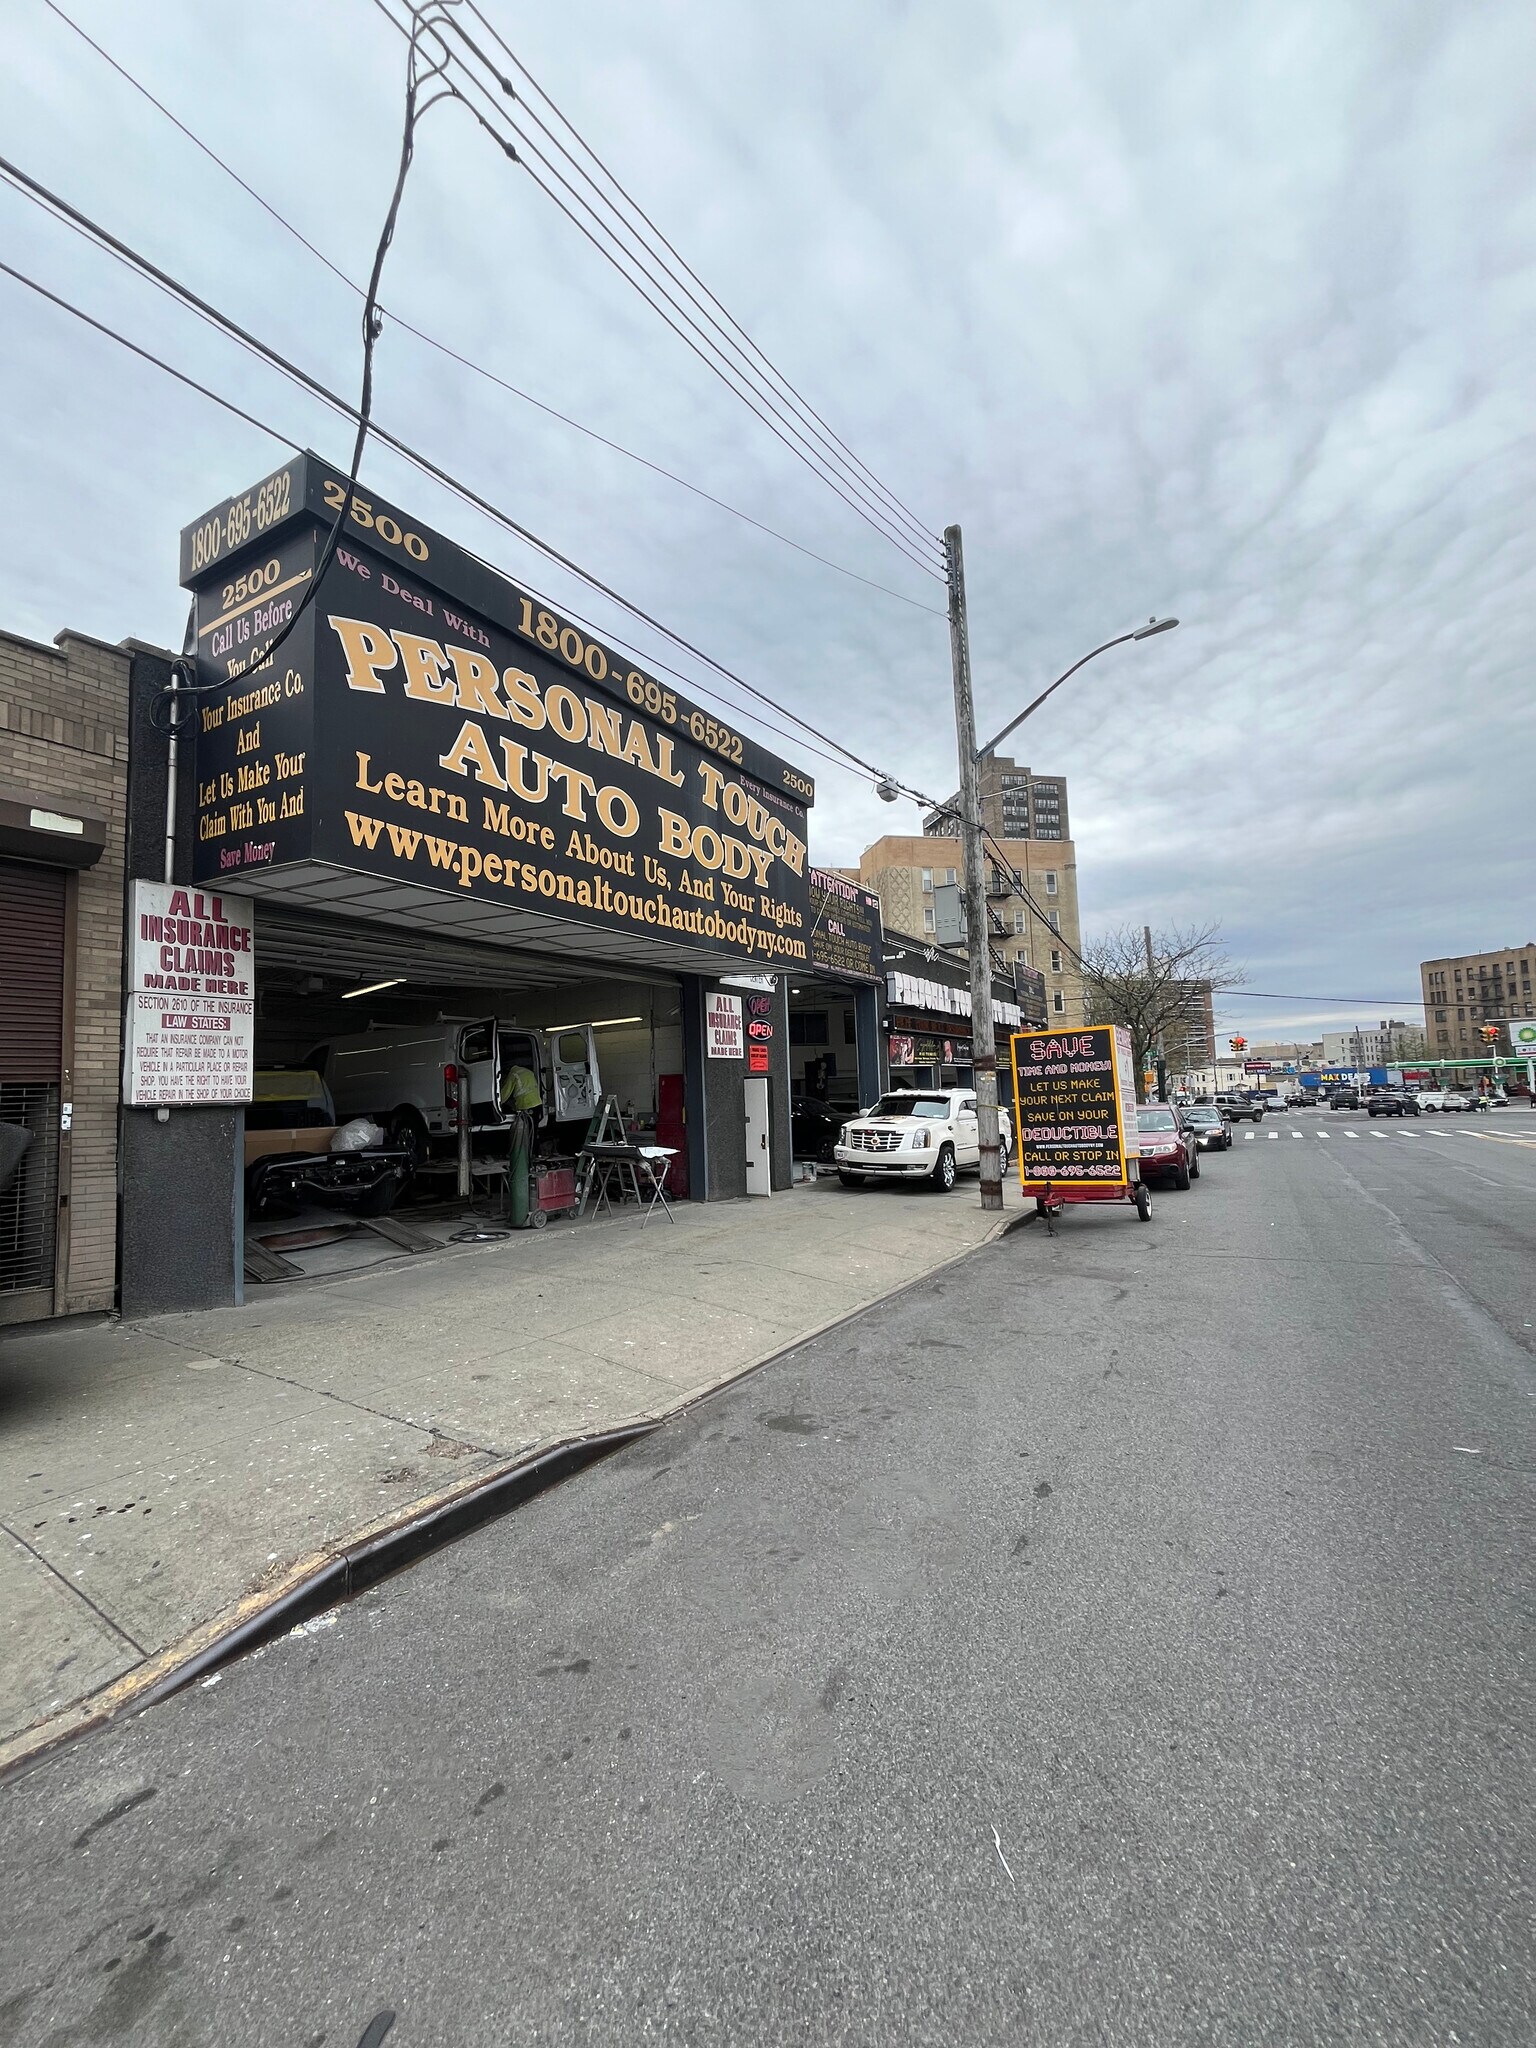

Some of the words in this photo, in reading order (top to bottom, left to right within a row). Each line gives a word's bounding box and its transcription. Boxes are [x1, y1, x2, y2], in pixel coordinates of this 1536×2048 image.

[190, 471, 290, 572] 1800-695-6522
[323, 480, 431, 562] 2500
[222, 560, 280, 610] 2500
[336, 547, 371, 580] We
[381, 574, 433, 617] Deal
[443, 607, 490, 648] With
[211, 629, 233, 658] Call
[237, 617, 249, 642] Us
[254, 598, 293, 635] Before
[517, 596, 744, 766] 1800-695-6522
[202, 704, 223, 733] Your
[227, 681, 281, 726] Insurance
[285, 671, 304, 695] Co.
[237, 721, 261, 755] And
[327, 614, 685, 788] PERSONAL
[698, 761, 807, 878] TOUCH
[200, 781, 217, 807] Let
[220, 773, 234, 796] Us
[238, 760, 270, 791] Make
[276, 751, 305, 778] Your
[782, 769, 814, 799] 2500
[439, 720, 640, 839] AUTO
[658, 806, 774, 890] BODY
[740, 775, 760, 796] Every
[763, 788, 793, 812] Insurance
[795, 805, 805, 819] Co.
[200, 808, 227, 841] Claim
[230, 799, 253, 832] With
[257, 794, 277, 821] You
[280, 786, 304, 815] And
[356, 750, 468, 824] Learn
[483, 796, 555, 850] More
[566, 832, 634, 878] About
[643, 857, 672, 891] Us,
[678, 867, 715, 902] And
[721, 880, 756, 916] Your
[760, 898, 802, 934] Rights
[220, 843, 242, 869] Save
[244, 840, 275, 865] Money
[169, 891, 228, 923] ALL
[141, 914, 251, 952] INSURANCE
[828, 920, 845, 936] CALL
[160, 945, 235, 977] CLAIMS
[144, 974, 201, 992] MADE
[205, 979, 249, 995] HERE
[139, 996, 169, 1010] SECTION
[172, 998, 187, 1011] 2610
[191, 999, 200, 1011] OF
[203, 1000, 215, 1012] THE
[218, 1001, 252, 1015] INSURANCE
[716, 996, 734, 1013] ALL
[751, 996, 771, 1015] OPEN
[166, 1015, 187, 1028] LAW
[192, 1017, 227, 1030] STATES:
[708, 1012, 742, 1030] INSURANCE
[749, 1023, 773, 1036] OPEN
[146, 1033, 159, 1043] THAT
[161, 1034, 168, 1043] AN
[170, 1035, 197, 1045] INSURANCE
[199, 1036, 221, 1045] COMPANY
[224, 1036, 233, 1046] CAN
[234, 1036, 243, 1046] NOT
[715, 1030, 737, 1046] CLAIMS
[1030, 1035, 1094, 1060] SAVE
[136, 1047, 159, 1057] REQUIRE
[161, 1048, 173, 1057] THAT
[175, 1048, 193, 1058] REPAIR
[194, 1048, 201, 1058] BE
[203, 1048, 216, 1058] MADE
[219, 1048, 225, 1058] TO
[227, 1049, 231, 1058] A
[232, 1049, 248, 1059] MOTOR
[711, 1047, 727, 1056] MADE
[729, 1048, 742, 1057] HERE
[140, 1061, 160, 1072] VEHICLE
[163, 1062, 168, 1072] IN
[170, 1062, 173, 1072] A
[176, 1062, 205, 1073] PARTICULAR
[207, 1062, 222, 1072] PLACE
[224, 1063, 231, 1072] OR
[232, 1063, 247, 1073] REPAIR
[1018, 1065, 1043, 1077] TIME
[1045, 1063, 1068, 1075] AND
[1070, 1060, 1111, 1073] MONEY!
[158, 1075, 169, 1086] YOU
[170, 1075, 183, 1086] HAVE
[186, 1075, 194, 1086] THE
[197, 1075, 211, 1086] RIGHT
[213, 1075, 219, 1086] TO
[221, 1075, 233, 1086] HAVE
[235, 1075, 247, 1086] YOUR
[1030, 1082, 1049, 1092] LET
[1053, 1081, 1068, 1091] US
[1071, 1079, 1100, 1090] MAKE
[136, 1089, 157, 1100] VEHICLE
[159, 1089, 176, 1100] REPAIR
[178, 1089, 183, 1100] IN
[185, 1089, 194, 1100] THE
[196, 1089, 209, 1100] SHOP
[212, 1089, 218, 1100] OF
[220, 1088, 233, 1100] YOUR
[234, 1088, 250, 1099] CHOICE
[1020, 1096, 1048, 1106] YOUR
[1051, 1093, 1078, 1104] NEXT
[1081, 1091, 1114, 1102] CLAIM
[1028, 1112, 1056, 1122] SAVE
[1059, 1110, 1074, 1120] ON
[1077, 1109, 1109, 1120] YOUR
[1022, 1125, 1118, 1141] DEDUCTIBLE
[1025, 1151, 1051, 1161] CALL
[1054, 1151, 1069, 1161] OR
[1072, 1151, 1102, 1161] STOP
[1106, 1150, 1119, 1161] IN
[1025, 1165, 1121, 1177] 1-800-695-6522
